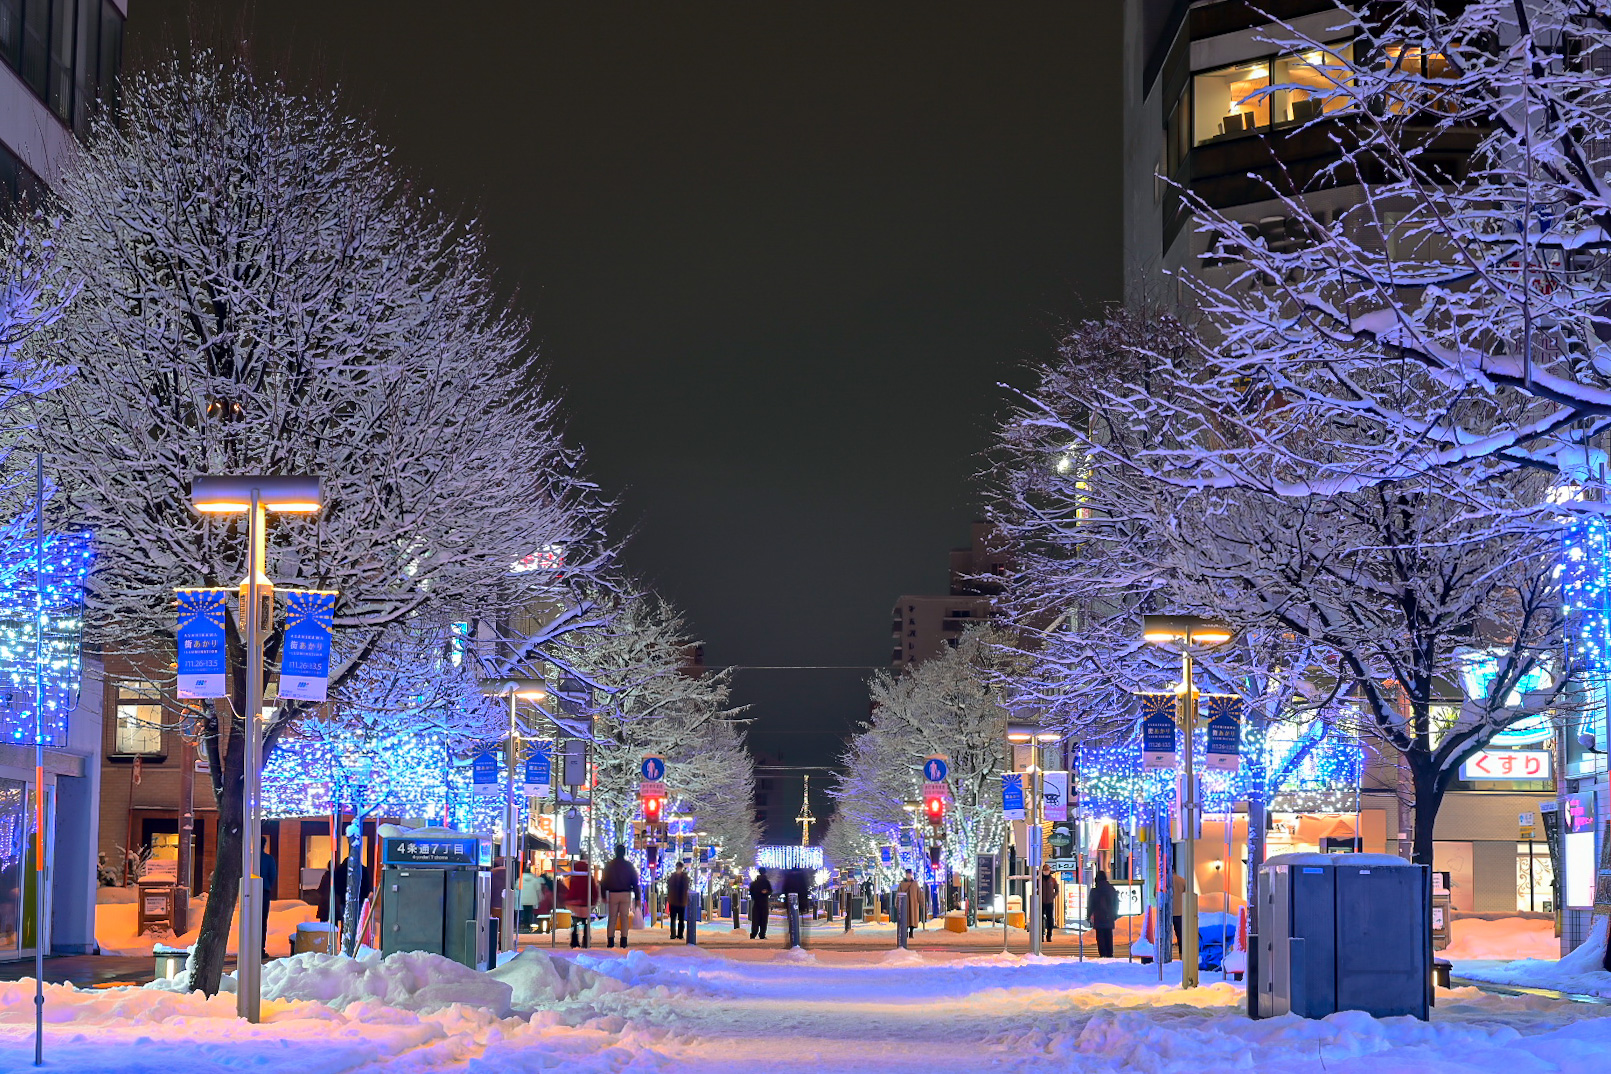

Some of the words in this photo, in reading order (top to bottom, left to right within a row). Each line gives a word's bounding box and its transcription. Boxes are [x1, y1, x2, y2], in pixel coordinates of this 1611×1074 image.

[1475, 754, 1541, 775] くすり
[397, 842, 464, 854] 4条通7丁目
